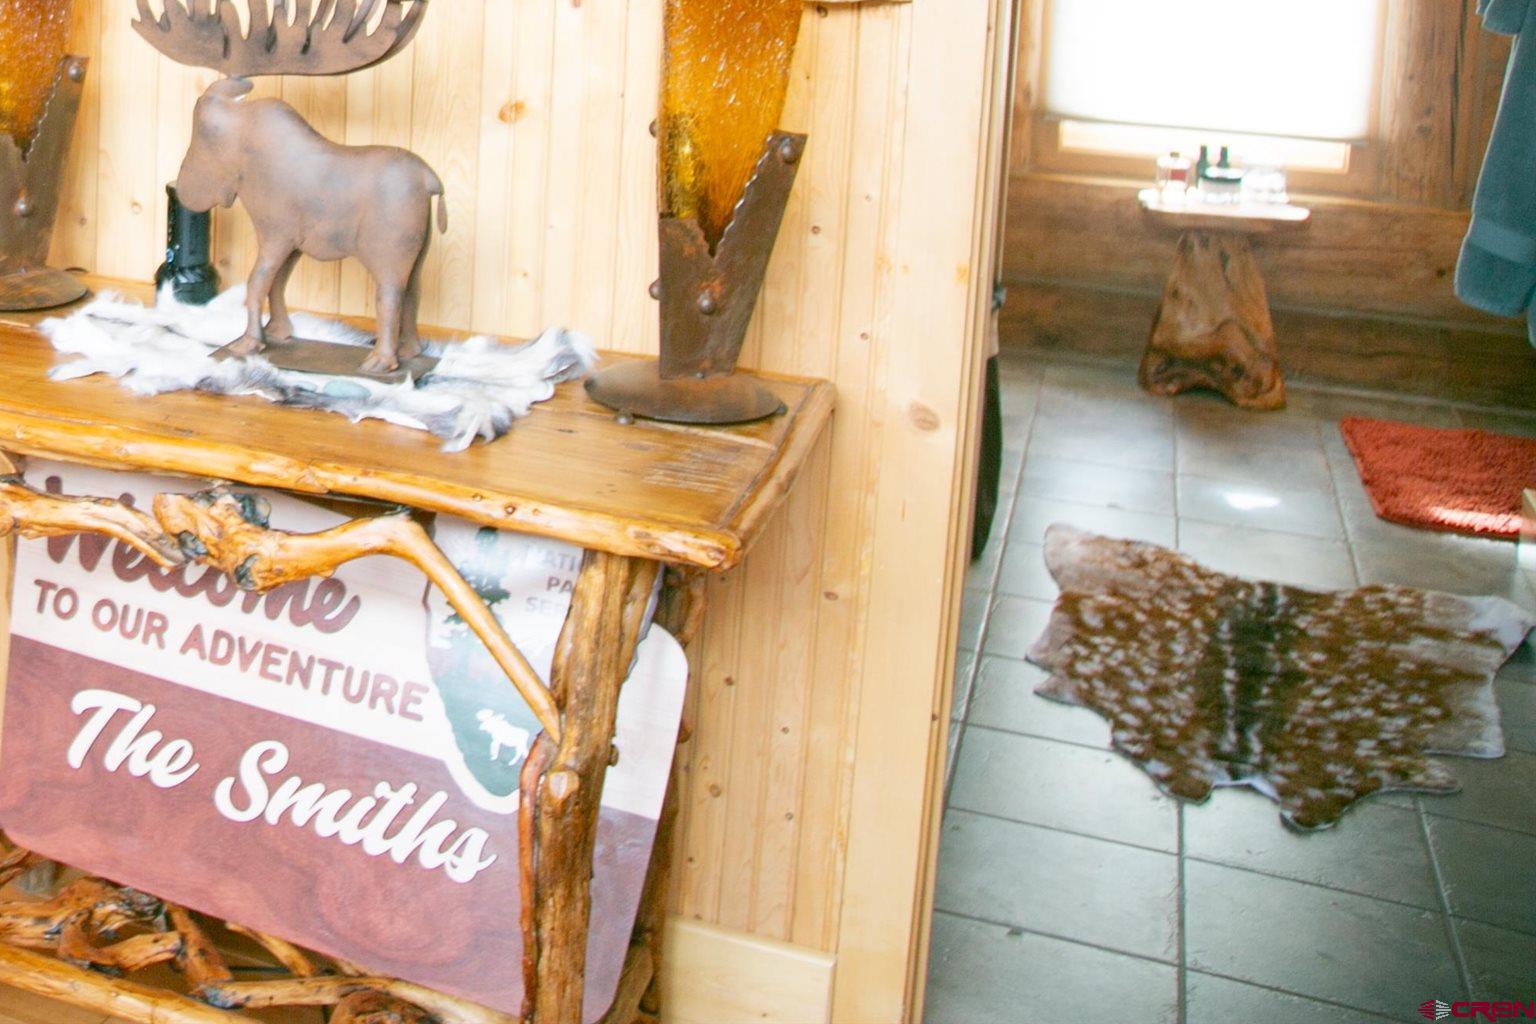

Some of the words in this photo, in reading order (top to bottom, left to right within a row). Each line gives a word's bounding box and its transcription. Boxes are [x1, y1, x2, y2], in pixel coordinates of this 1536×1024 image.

[34, 579, 78, 620] TO
[92, 598, 169, 649] OUR
[179, 624, 430, 722] ADVENTURE
[67, 689, 200, 787] The
[214, 740, 497, 883] Smiths
